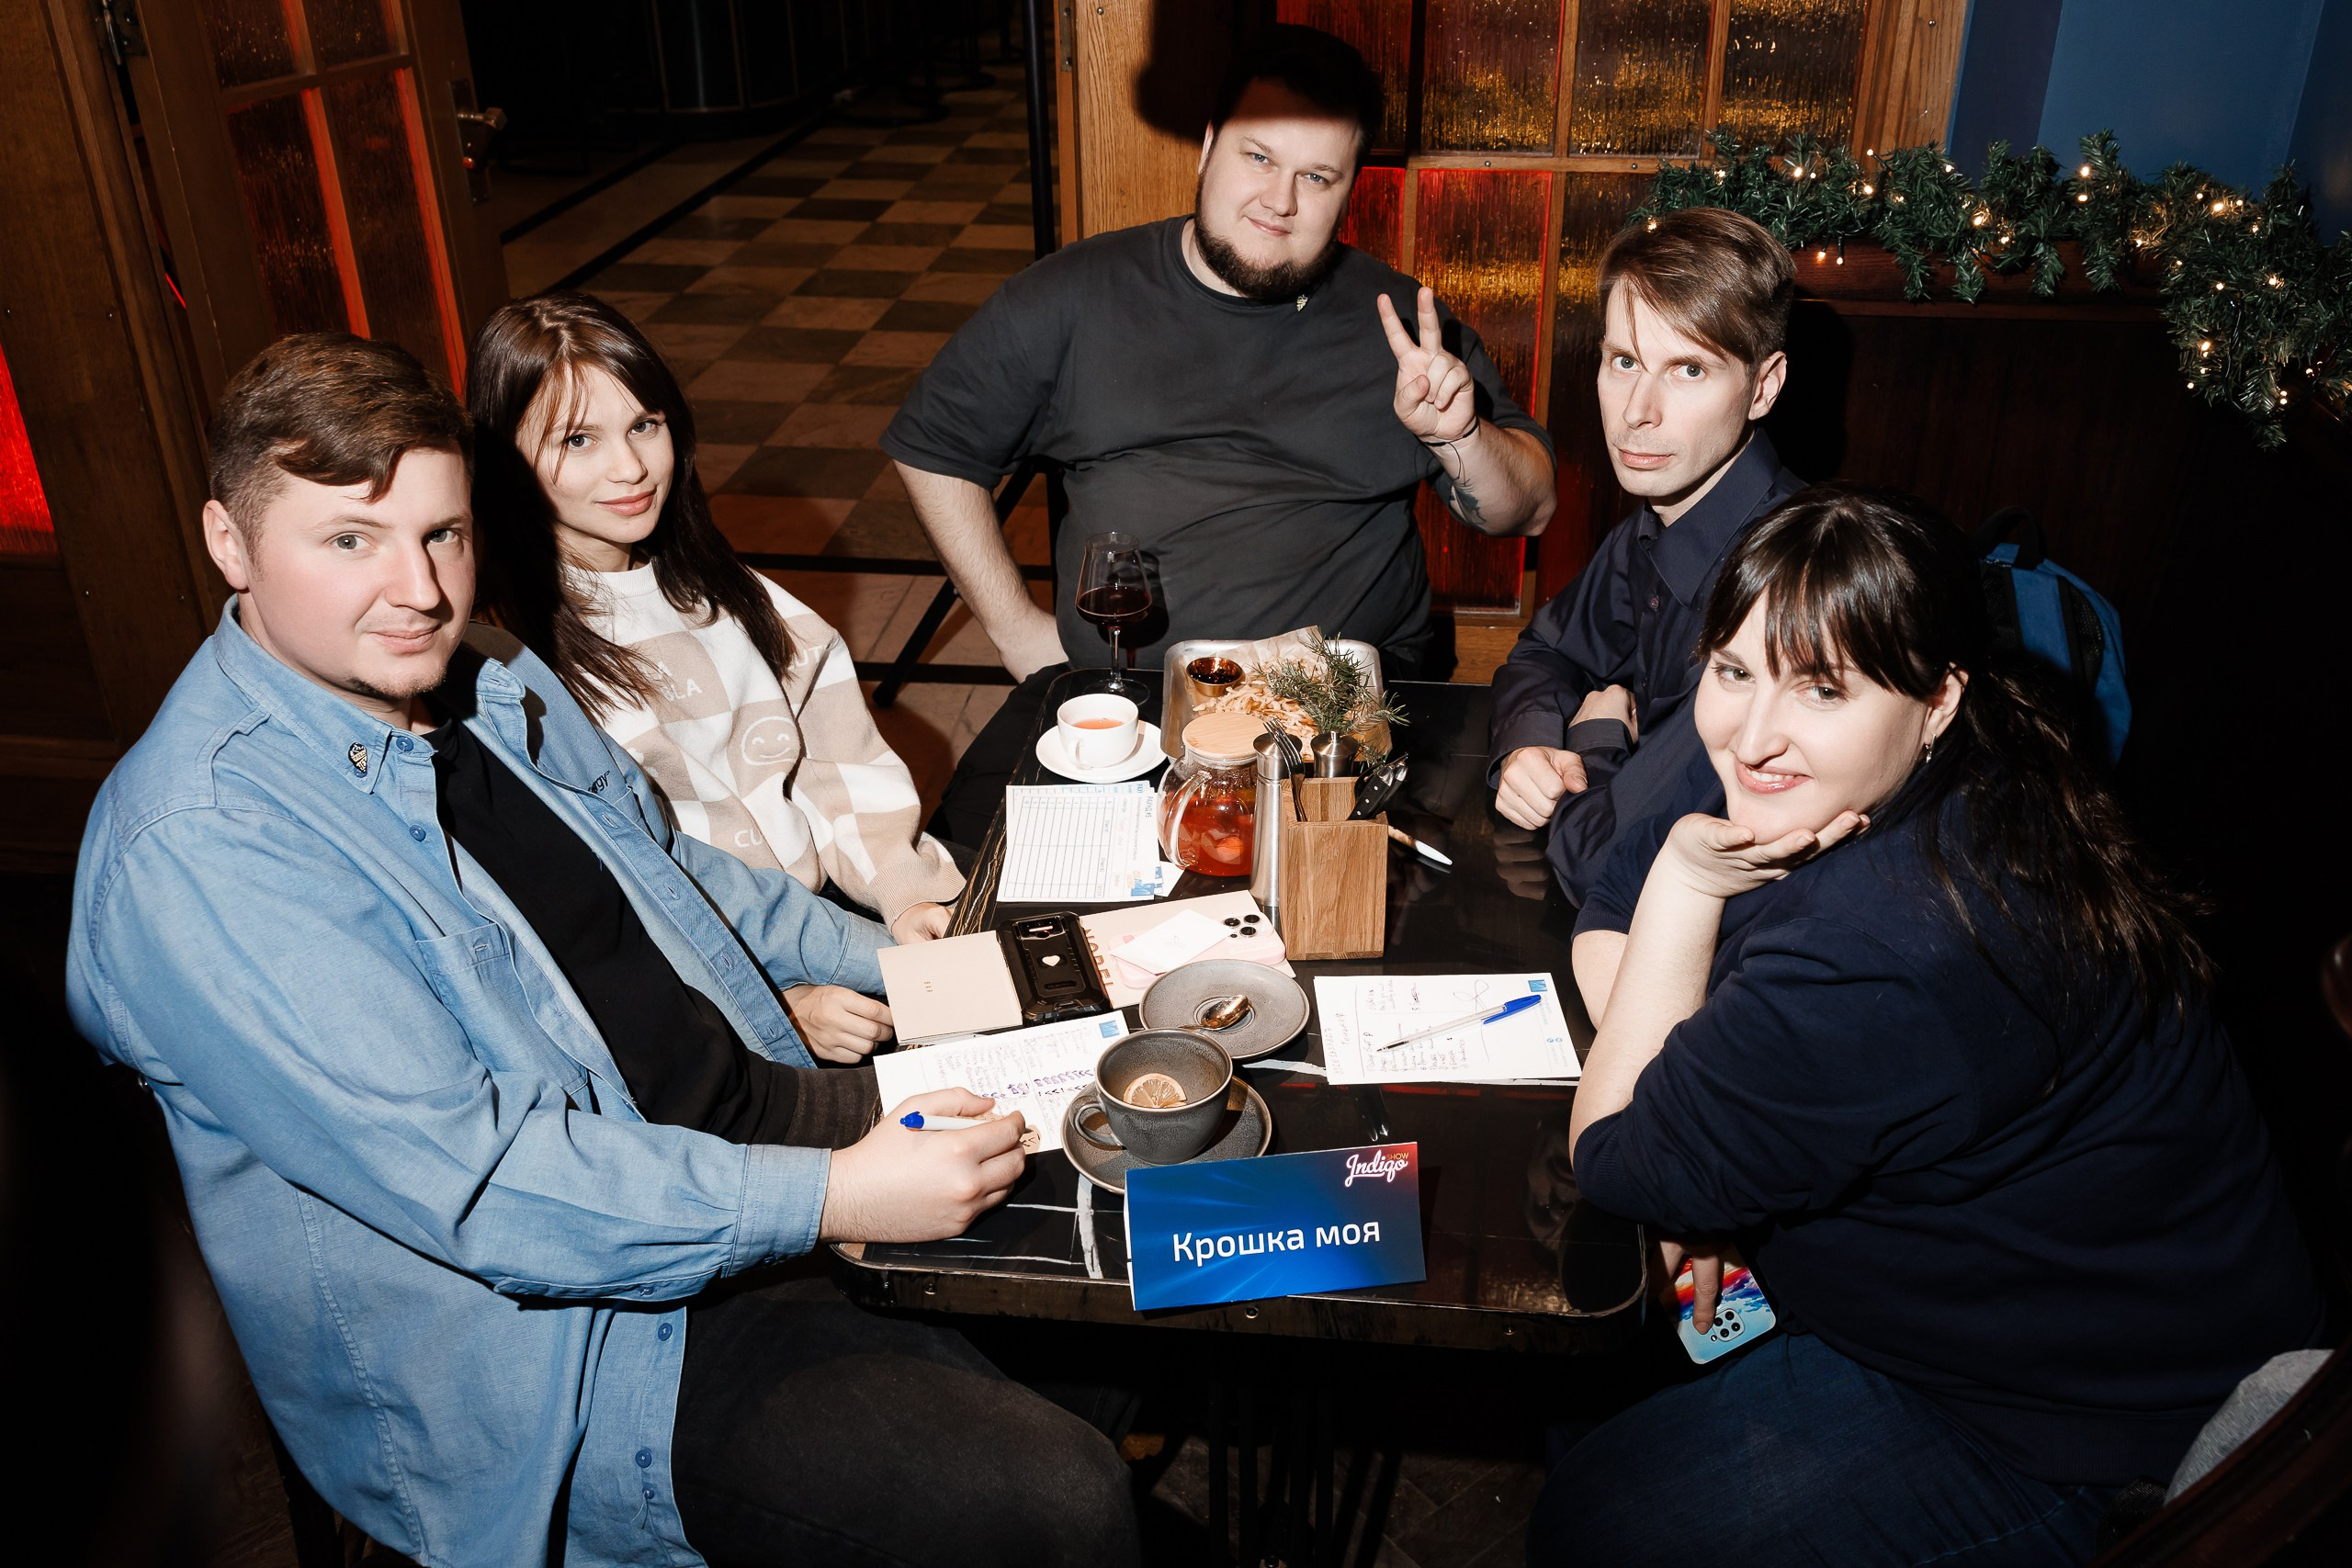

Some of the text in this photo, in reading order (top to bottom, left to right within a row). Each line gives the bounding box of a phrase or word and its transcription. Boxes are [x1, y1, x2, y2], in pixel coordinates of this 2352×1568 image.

[1344, 1149, 1409, 1188] Indigo SHOW
[1172, 1221, 1380, 1267] Крошка моя
